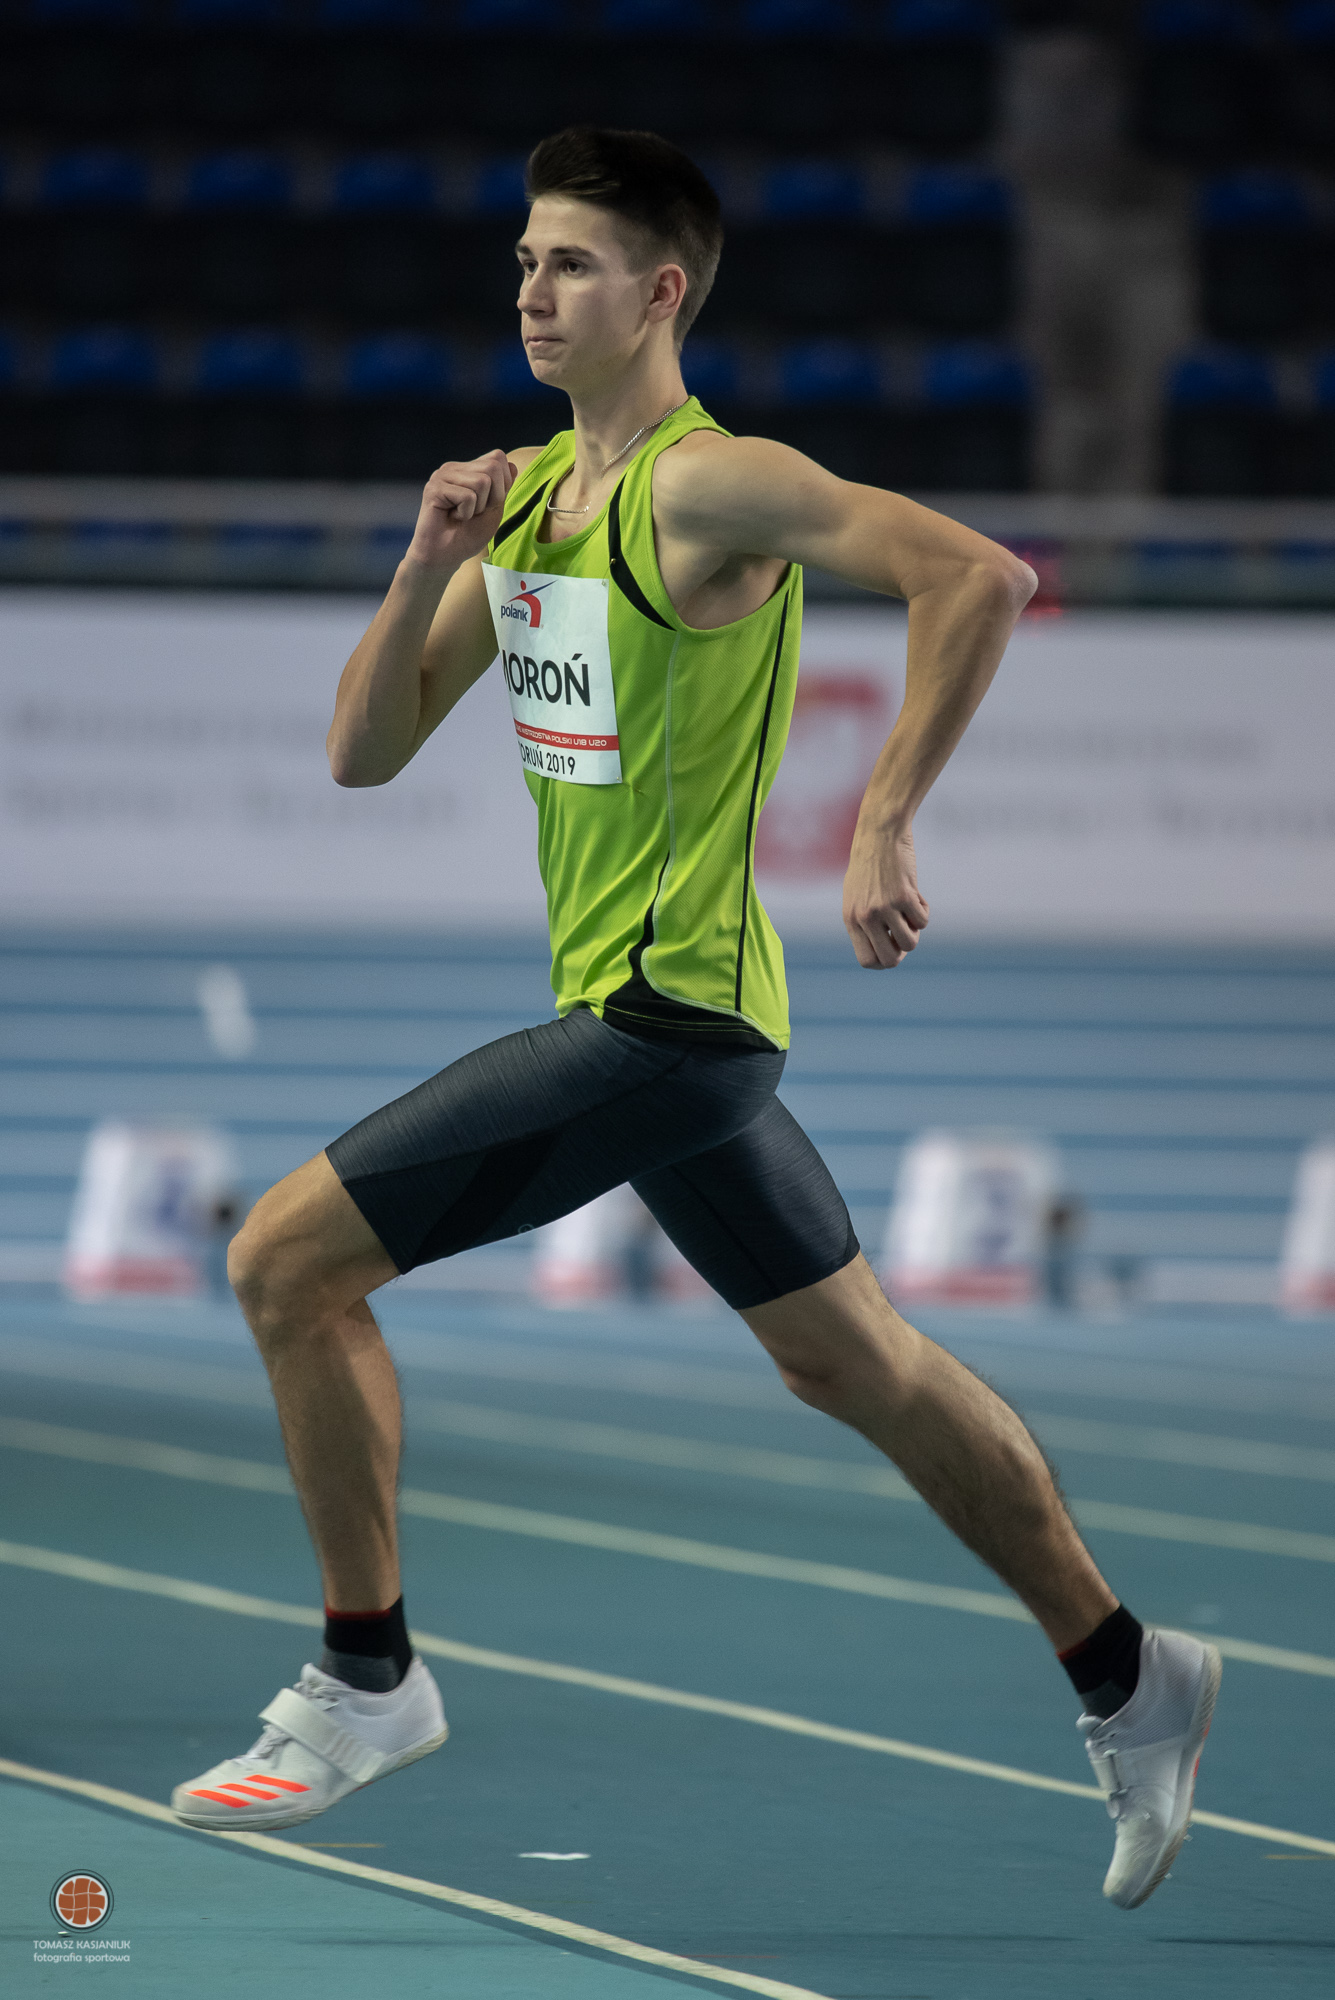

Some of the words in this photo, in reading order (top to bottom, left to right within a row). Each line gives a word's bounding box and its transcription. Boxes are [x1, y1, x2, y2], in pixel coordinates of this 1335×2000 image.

[501, 604, 528, 622] polanik
[551, 735, 573, 745] POLSKI
[573, 738, 587, 746] U18
[588, 739, 607, 747] U20
[518, 741, 544, 769] ORUŃ
[547, 752, 576, 775] 2019
